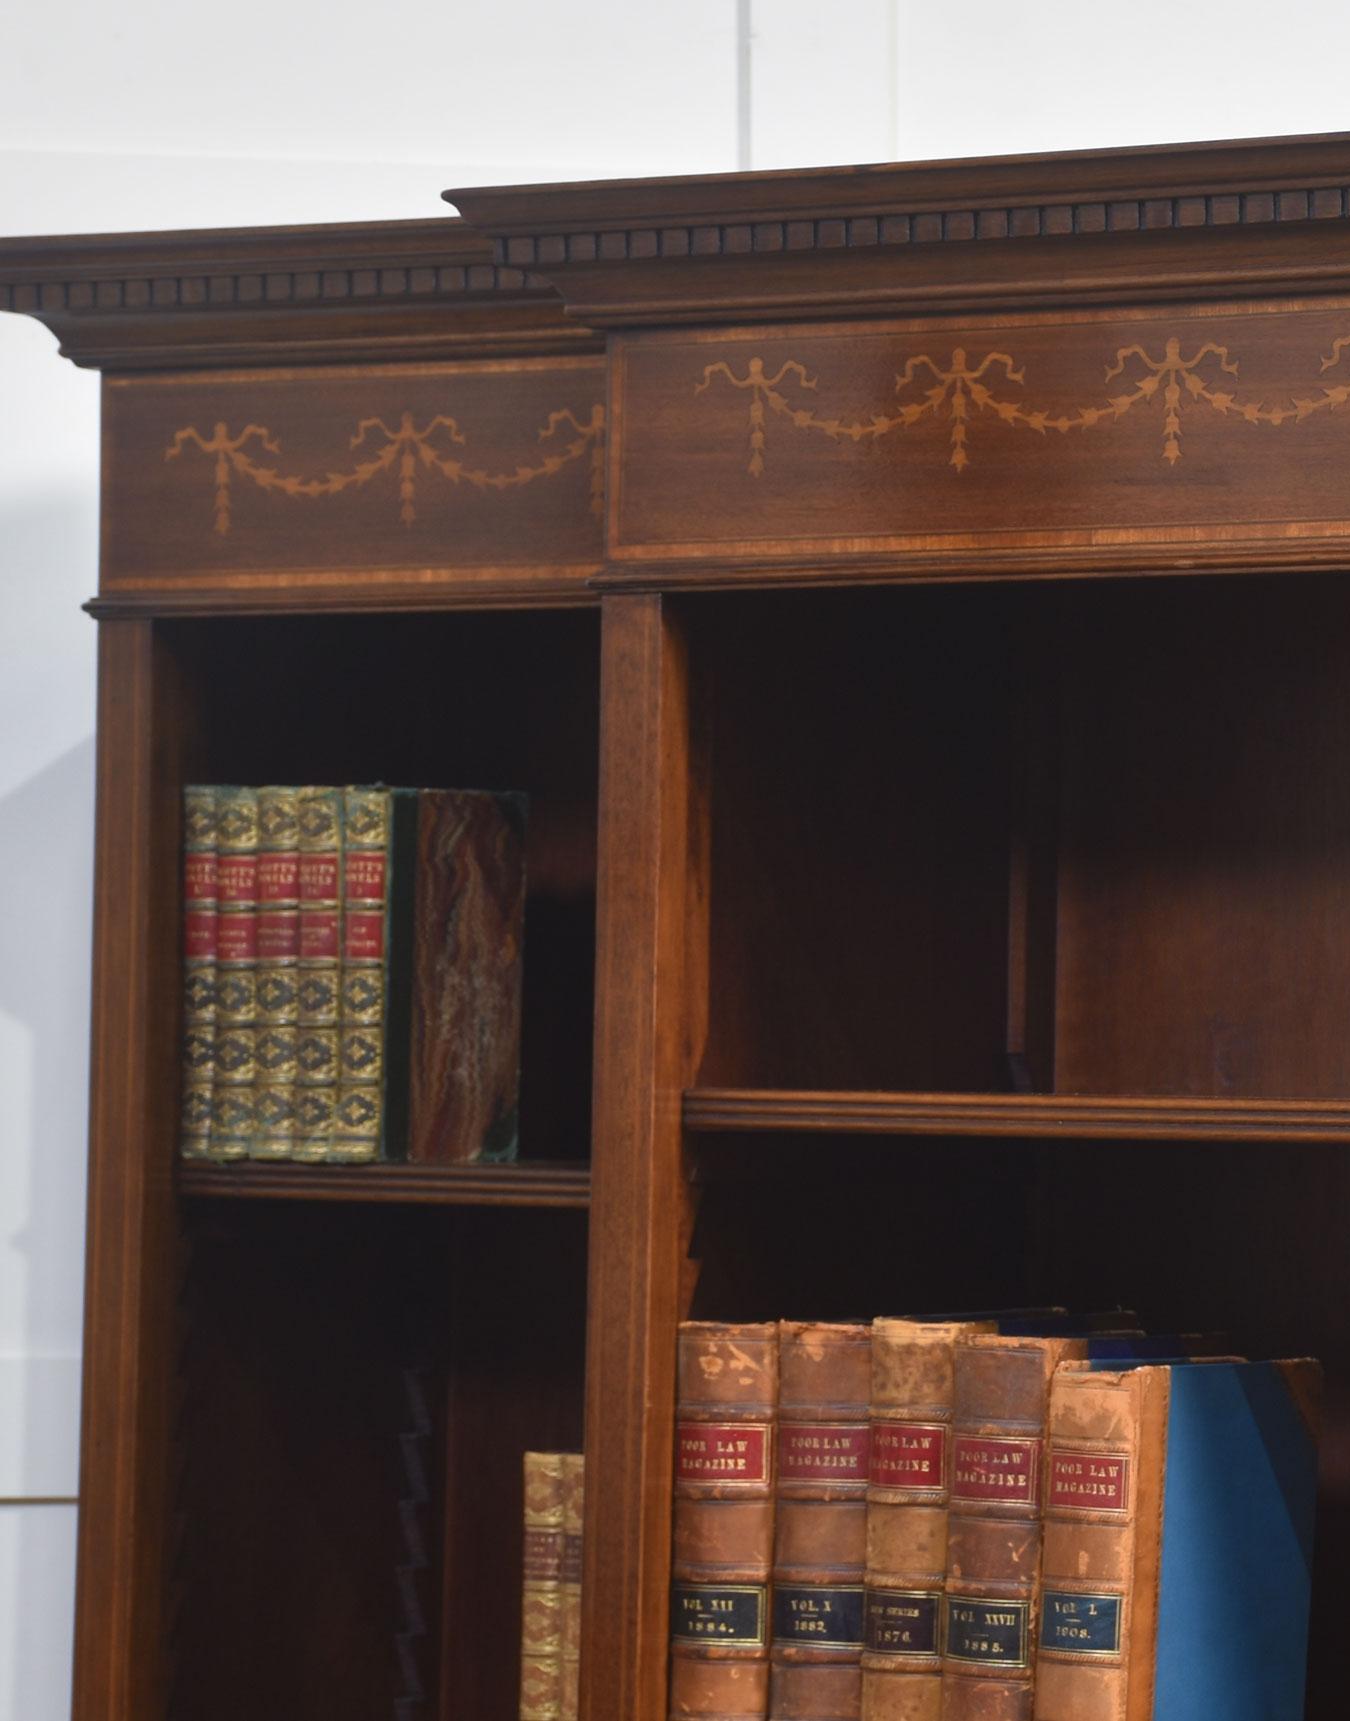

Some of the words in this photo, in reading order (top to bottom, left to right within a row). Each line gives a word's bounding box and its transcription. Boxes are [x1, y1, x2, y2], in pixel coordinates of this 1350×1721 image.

[717, 1440, 748, 1452] LAW
[823, 1437, 852, 1449] LAW
[902, 1436, 932, 1449] LAW
[992, 1453, 1023, 1464] LAW
[1055, 1462, 1082, 1474] POOR
[1090, 1465, 1119, 1478] LAW
[1055, 1482, 1117, 1497] MAGAZINE
